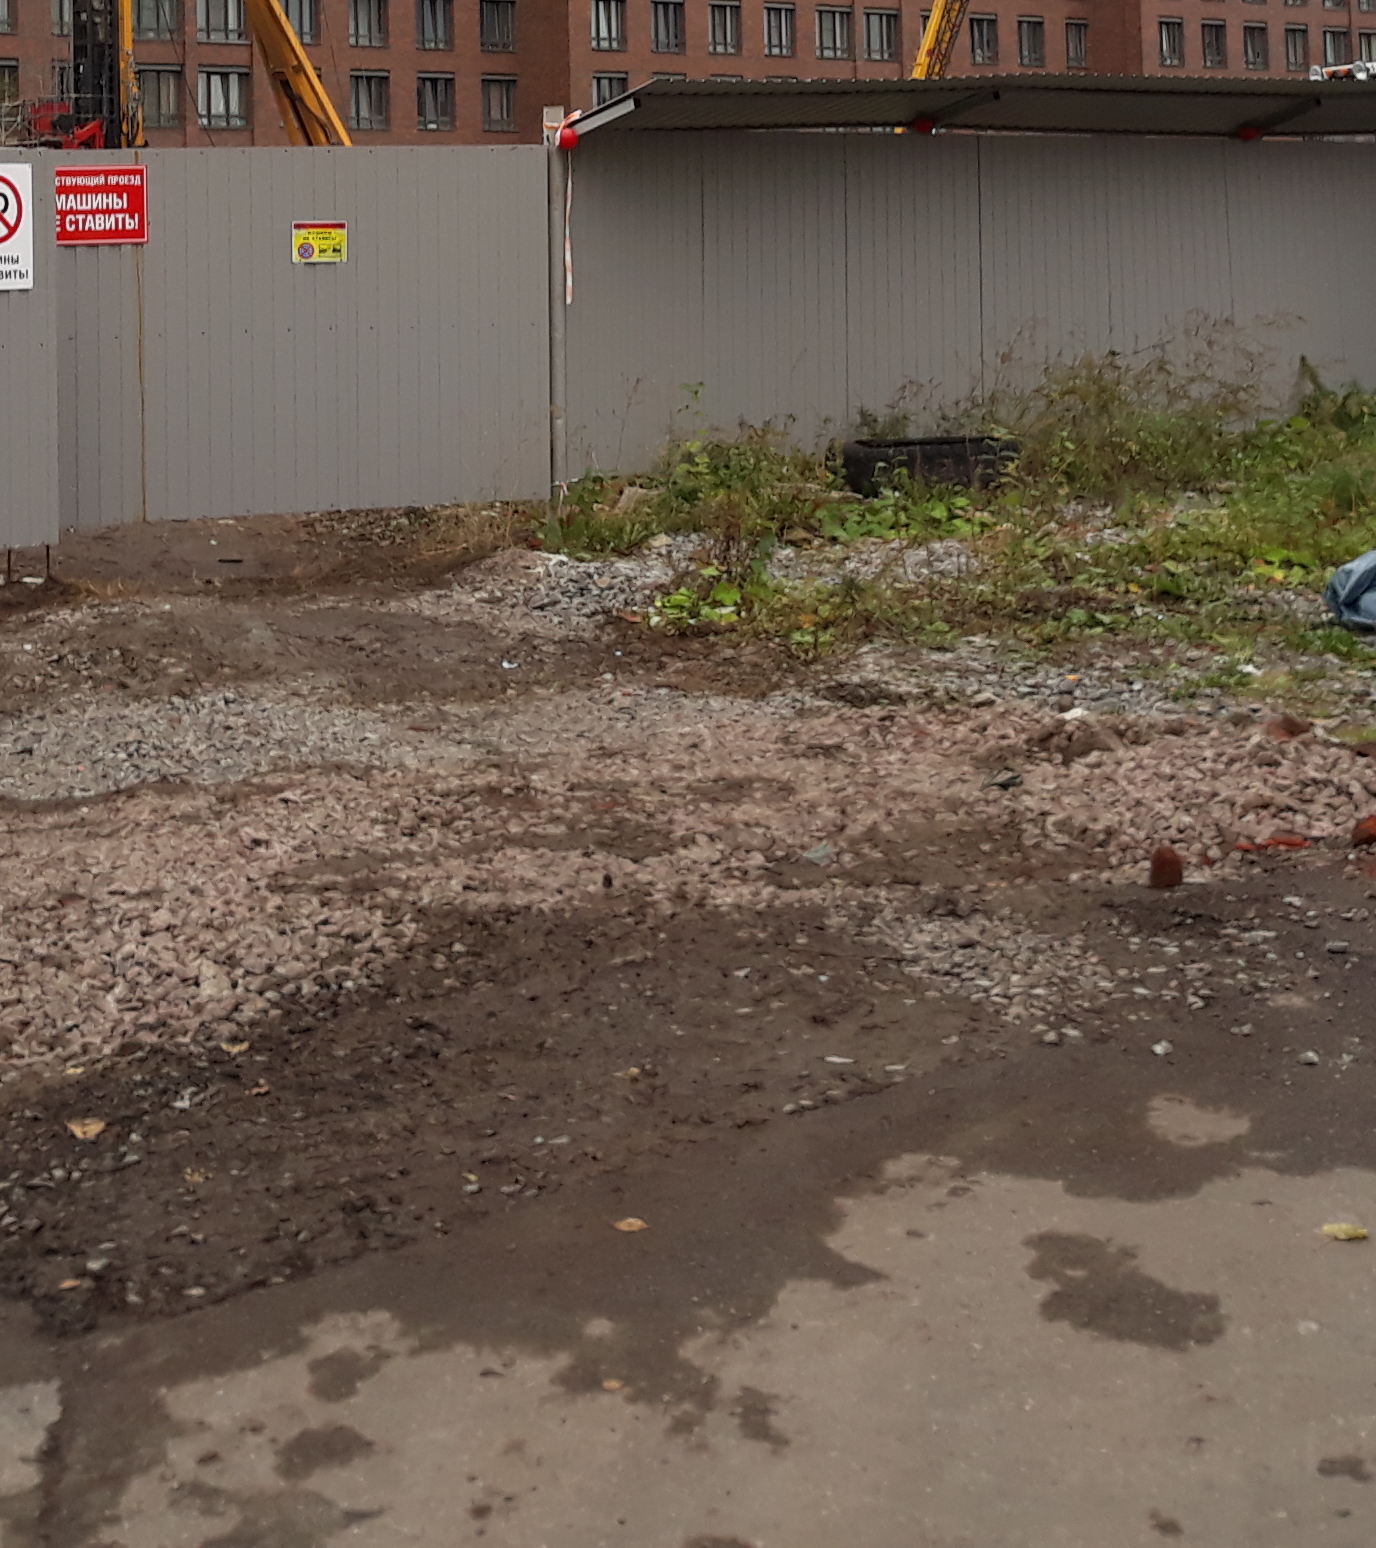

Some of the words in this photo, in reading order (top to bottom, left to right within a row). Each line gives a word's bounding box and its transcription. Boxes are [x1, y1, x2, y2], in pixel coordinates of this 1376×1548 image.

[107, 174, 141, 186] ПРОЕЗД
[55, 192, 128, 211] МАШИНЫ
[65, 212, 139, 231] СТАВИТЬ!
